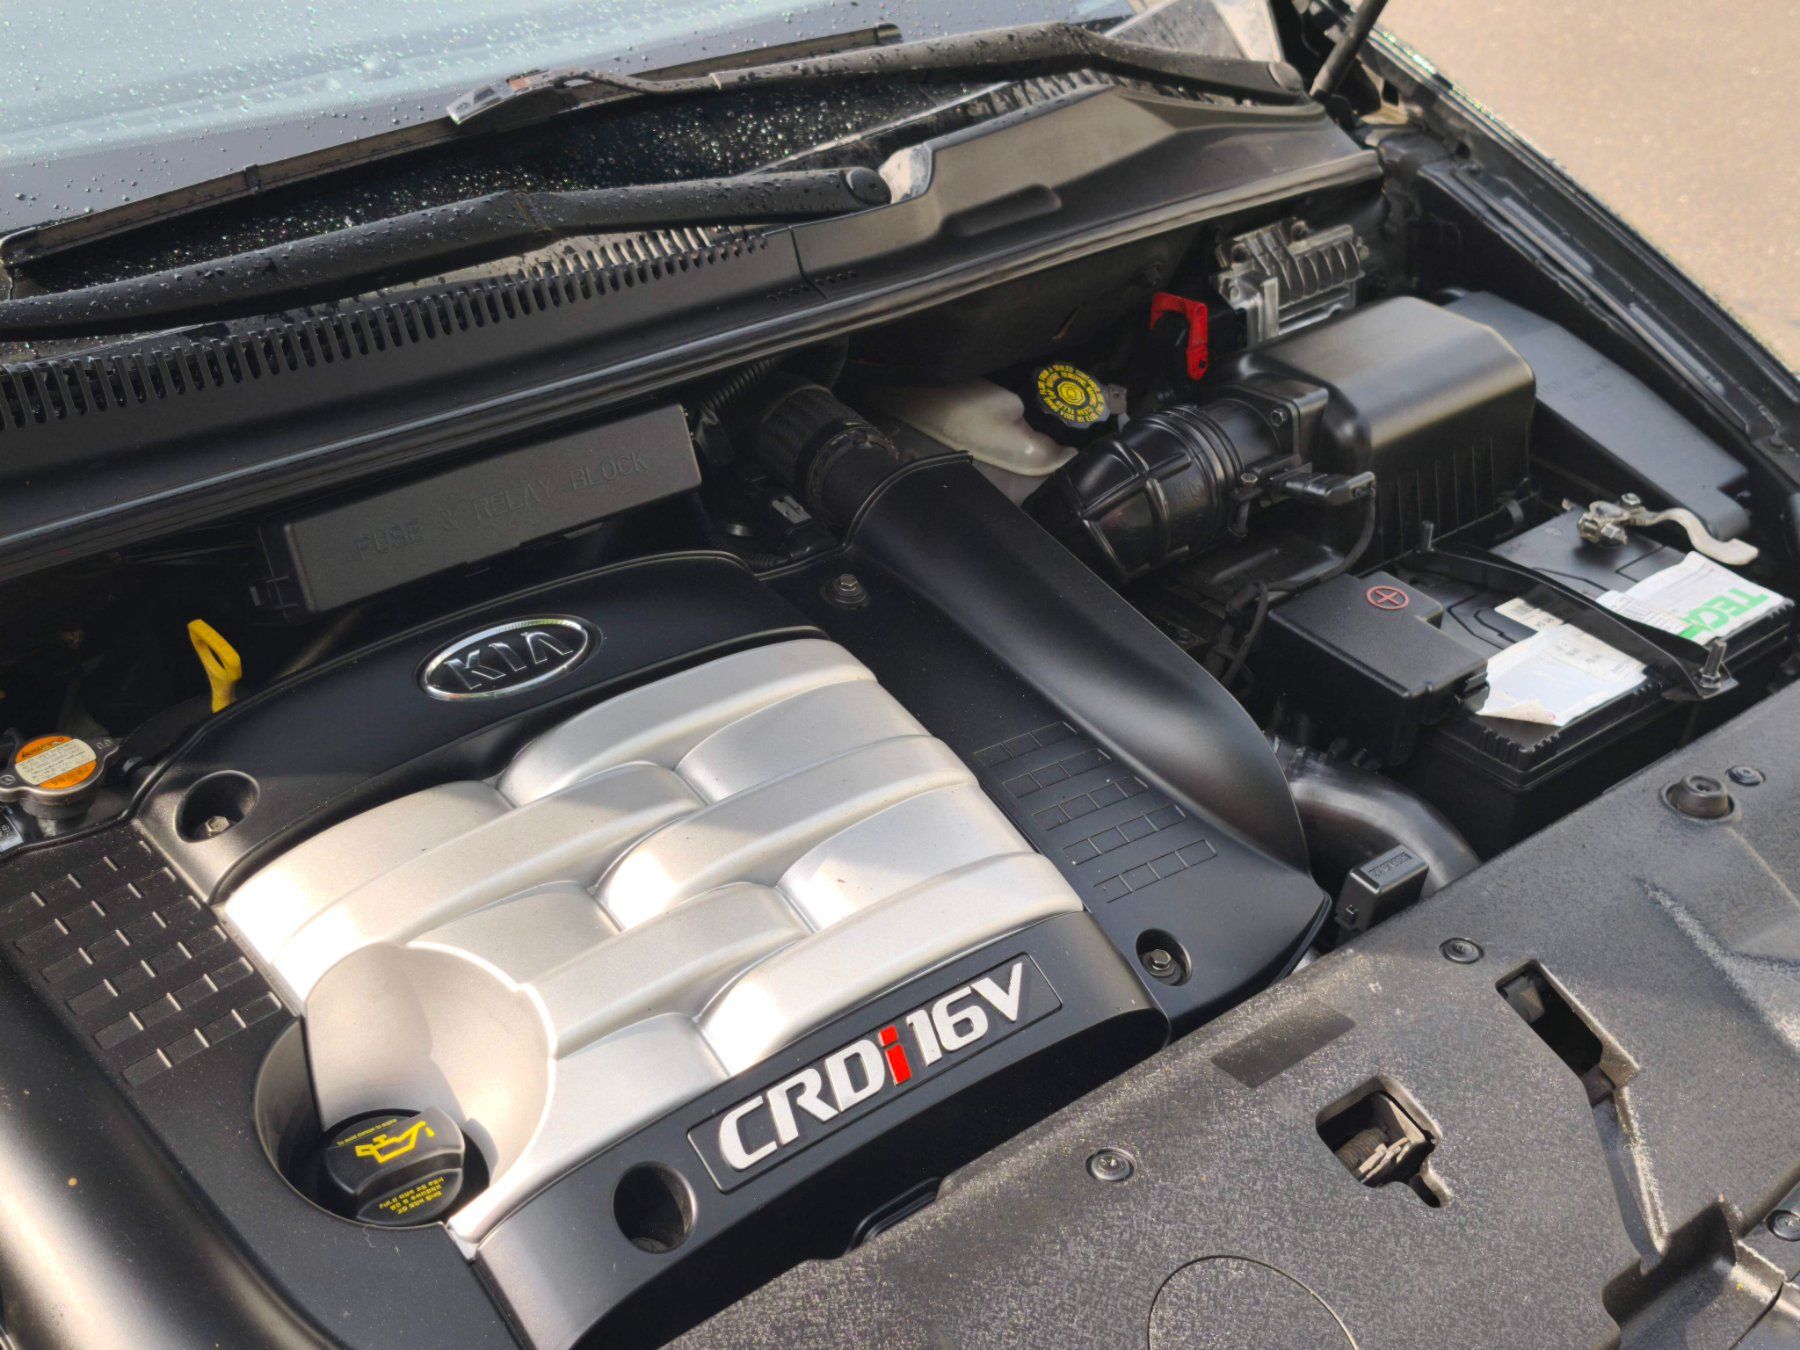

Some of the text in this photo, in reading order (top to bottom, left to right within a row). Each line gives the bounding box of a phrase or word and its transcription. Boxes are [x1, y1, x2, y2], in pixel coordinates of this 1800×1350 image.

[353, 449, 650, 562] FUSE & RELAY BLOCK
[444, 631, 574, 690] KIA
[718, 962, 1023, 1171] CRDi 16V
